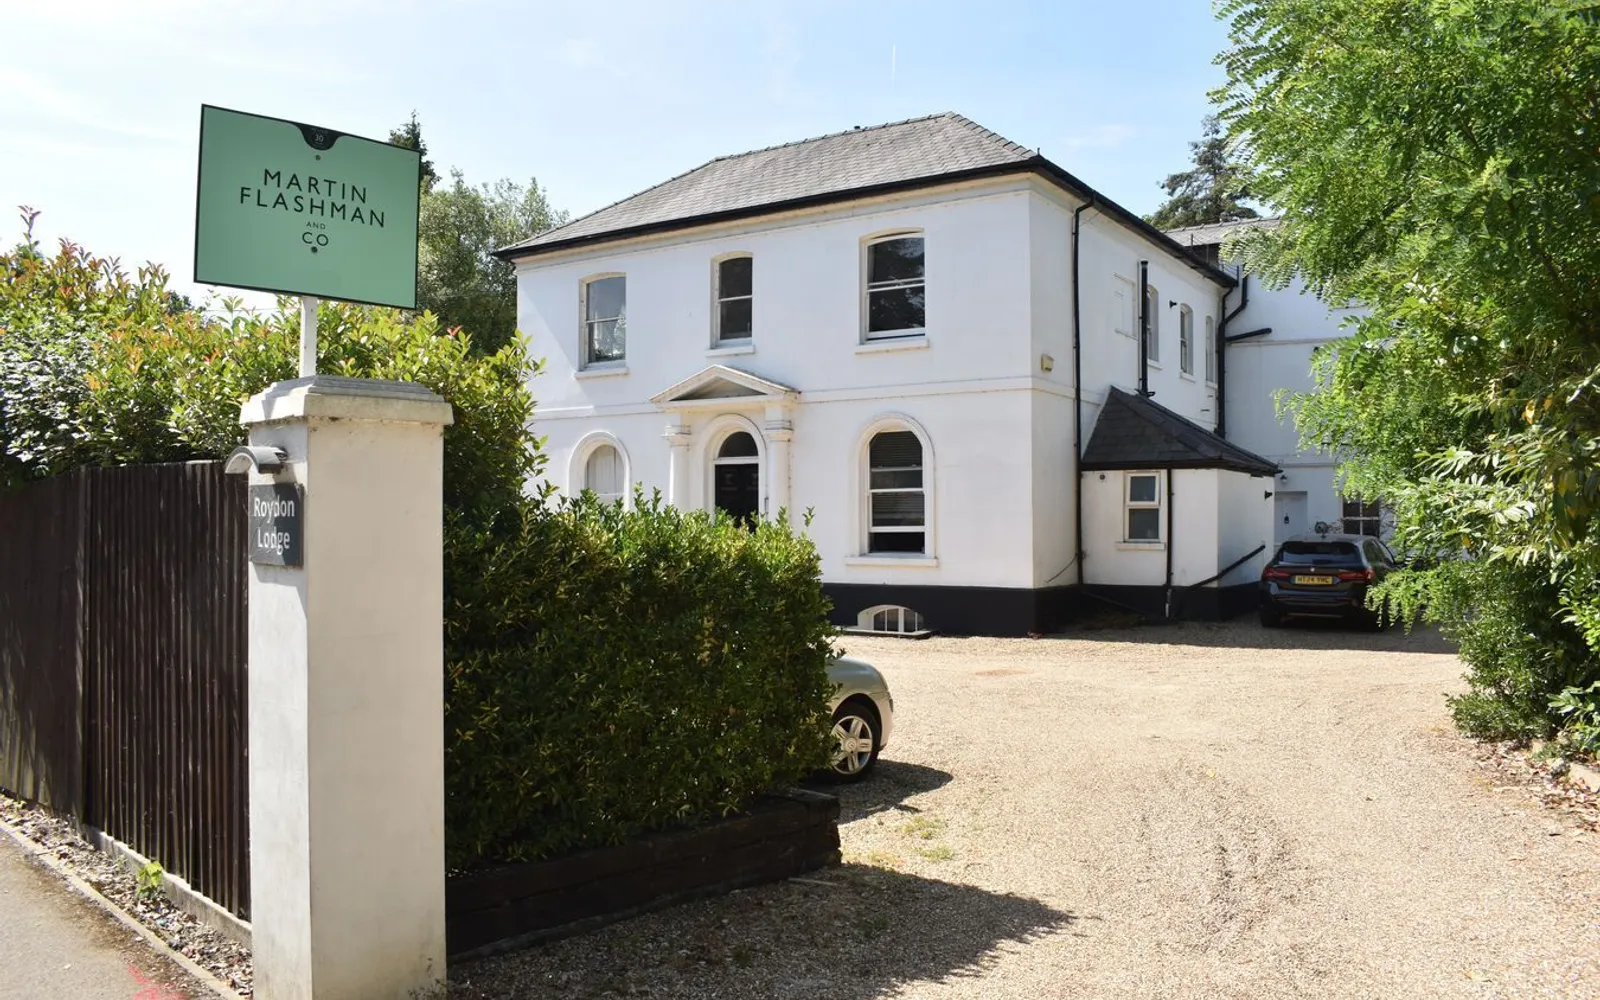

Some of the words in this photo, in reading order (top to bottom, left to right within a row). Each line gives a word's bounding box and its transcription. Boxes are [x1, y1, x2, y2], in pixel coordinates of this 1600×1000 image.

[264, 168, 367, 204] MARTIN
[240, 186, 385, 228] FLASHMAN
[302, 231, 329, 247] CO
[306, 222, 326, 230] AND
[253, 494, 295, 524] Roydon
[257, 526, 290, 556] Lodge
